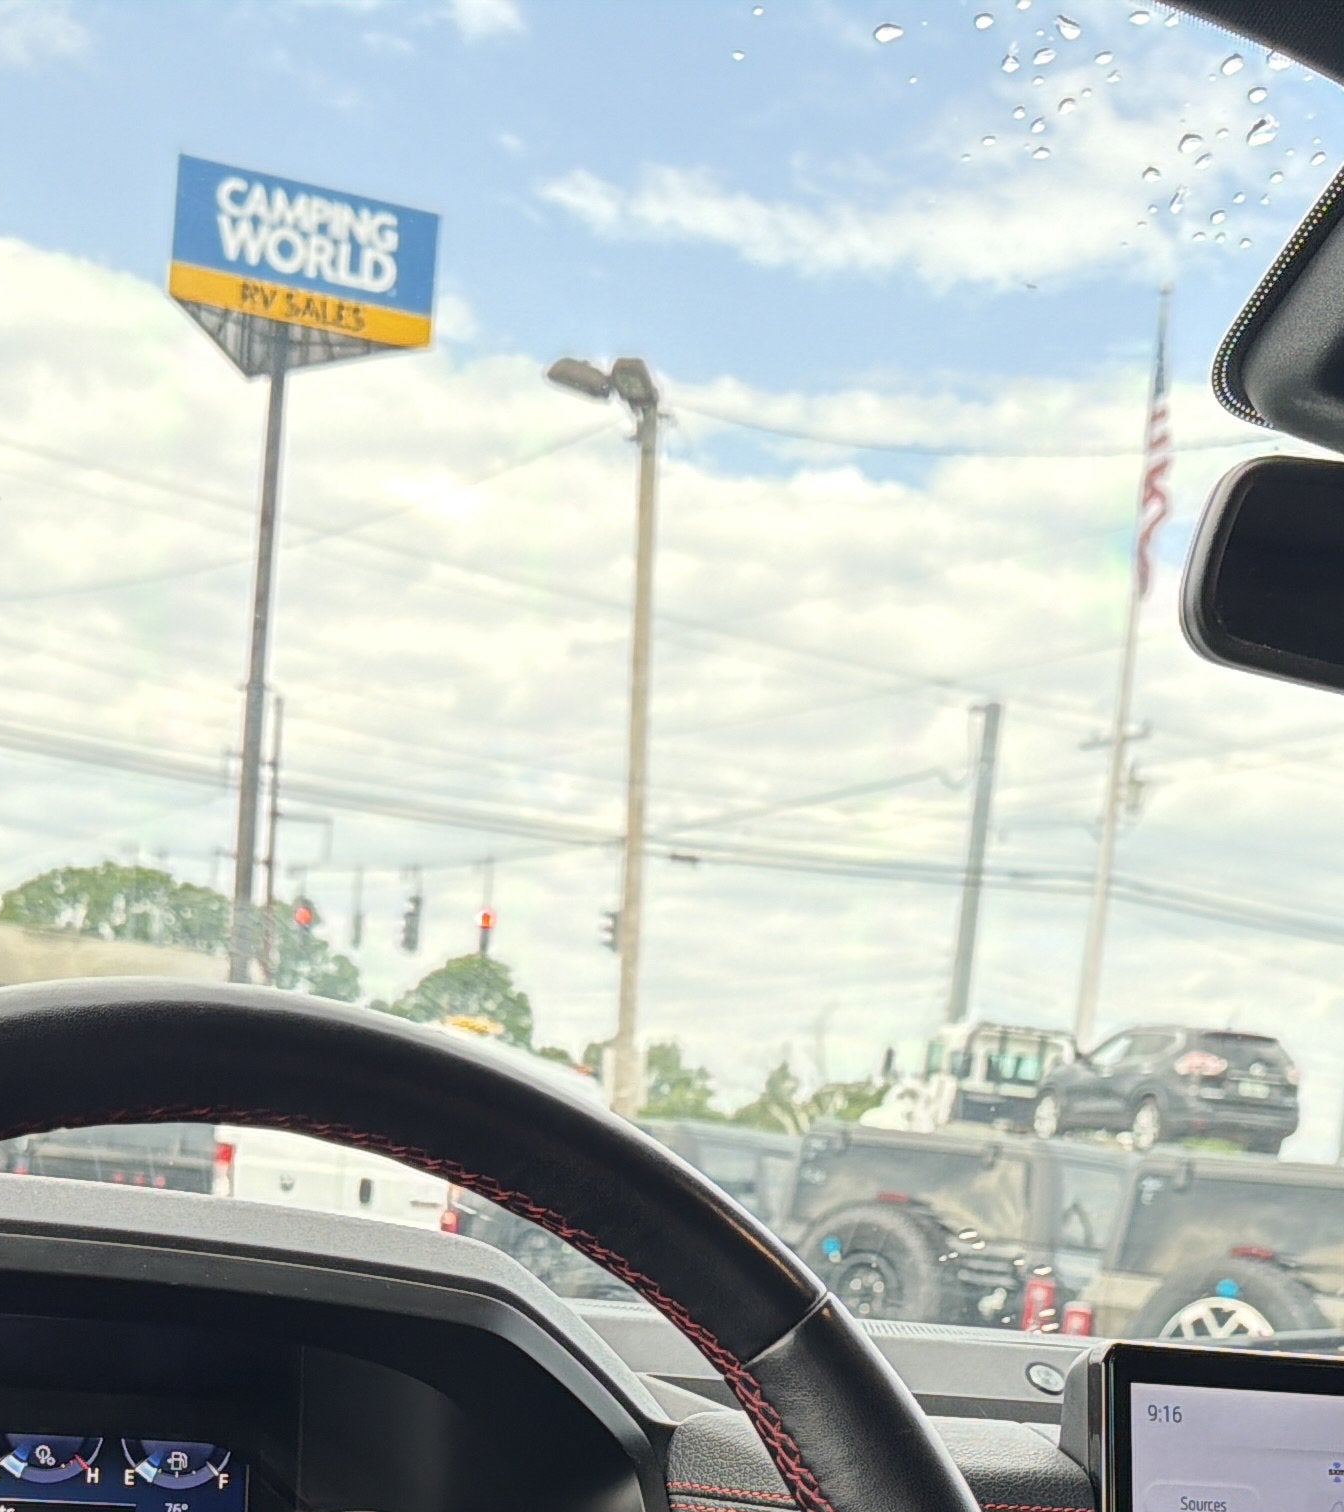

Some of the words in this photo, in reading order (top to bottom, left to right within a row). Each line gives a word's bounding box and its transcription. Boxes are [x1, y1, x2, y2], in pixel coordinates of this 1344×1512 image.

[216, 176, 399, 252] CAMPING
[217, 213, 398, 293] WORLD
[240, 280, 277, 309] RV
[284, 290, 365, 333] SALES
[1147, 1404, 1183, 1423] 9:16
[86, 1467, 99, 1484] H
[124, 1469, 135, 1486] E
[218, 1474, 229, 1489] F
[1180, 1496, 1227, 1512] Sources
